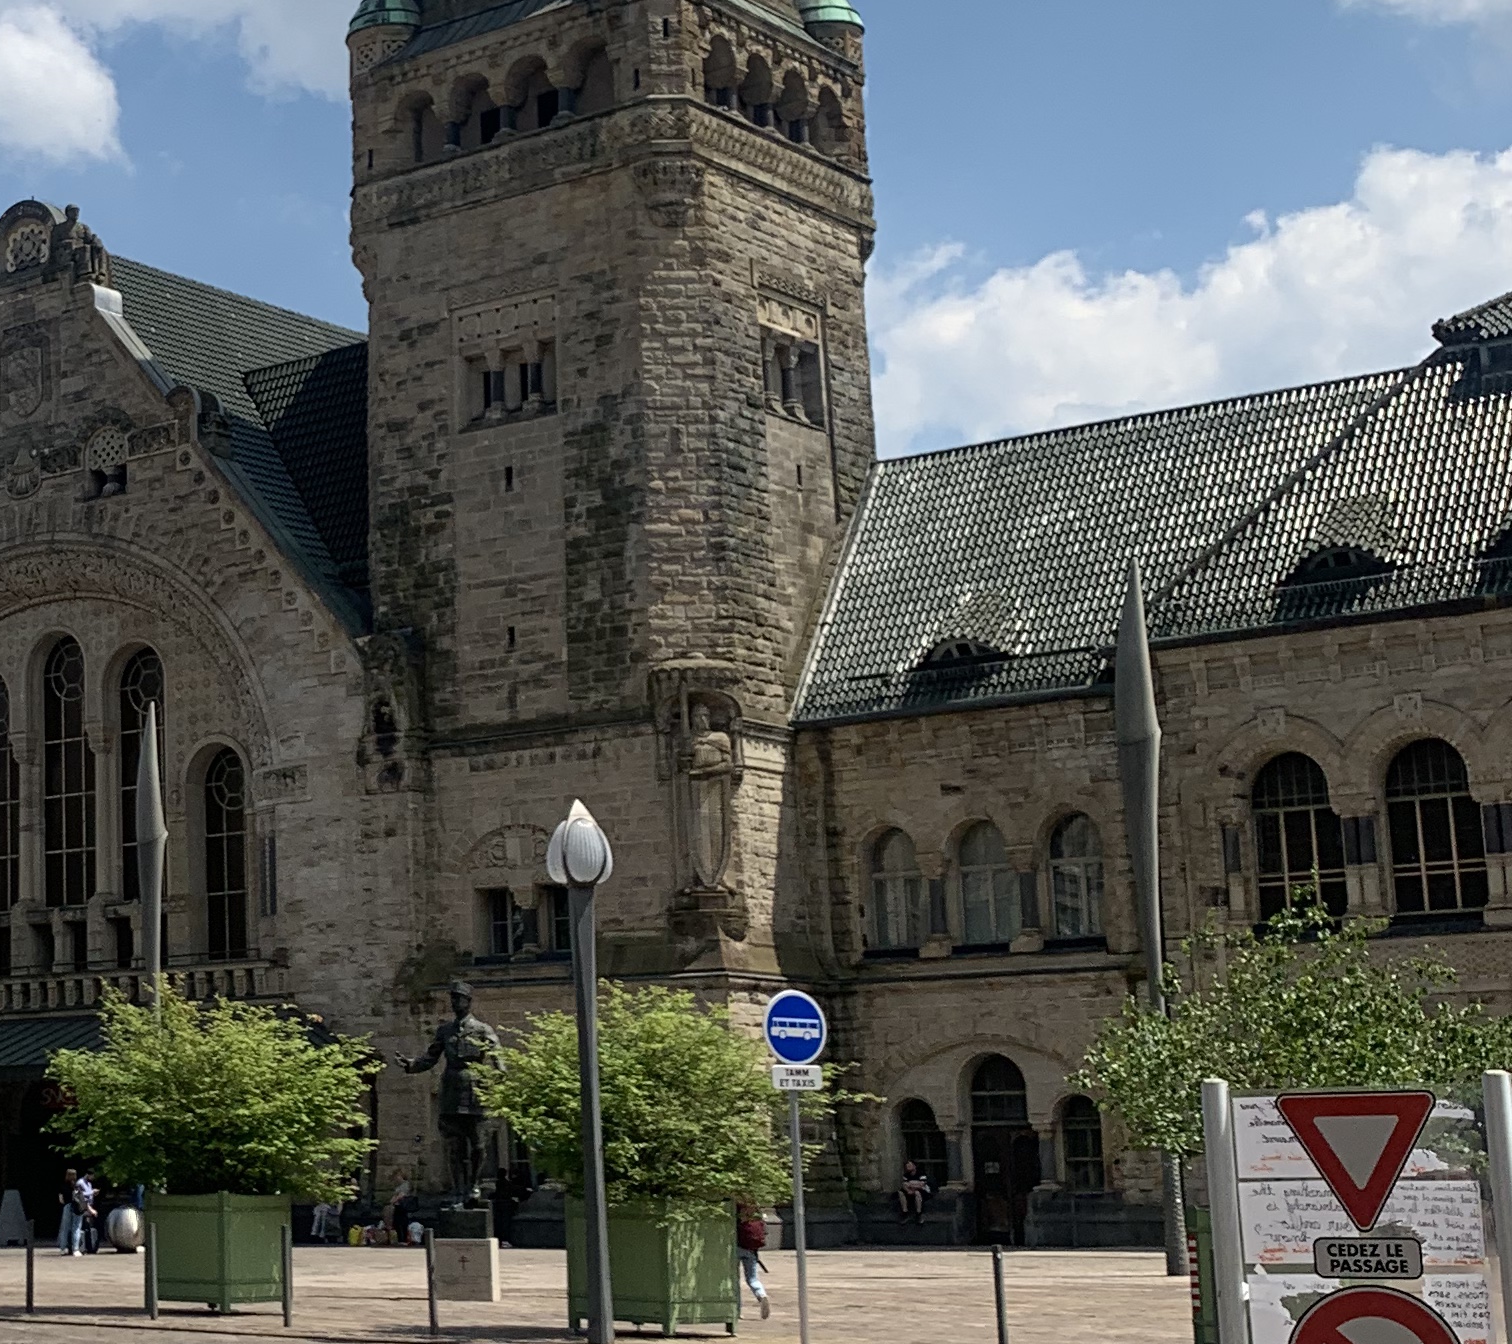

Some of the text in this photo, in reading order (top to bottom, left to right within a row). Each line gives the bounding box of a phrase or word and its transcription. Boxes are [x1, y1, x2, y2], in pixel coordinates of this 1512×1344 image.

[784, 1068, 810, 1077] TAMM
[779, 1079, 816, 1088] ET TAXIS
[1326, 1242, 1381, 1258] CEDEZ
[1386, 1243, 1404, 1258] LE
[1329, 1258, 1409, 1274] PASSAGE
